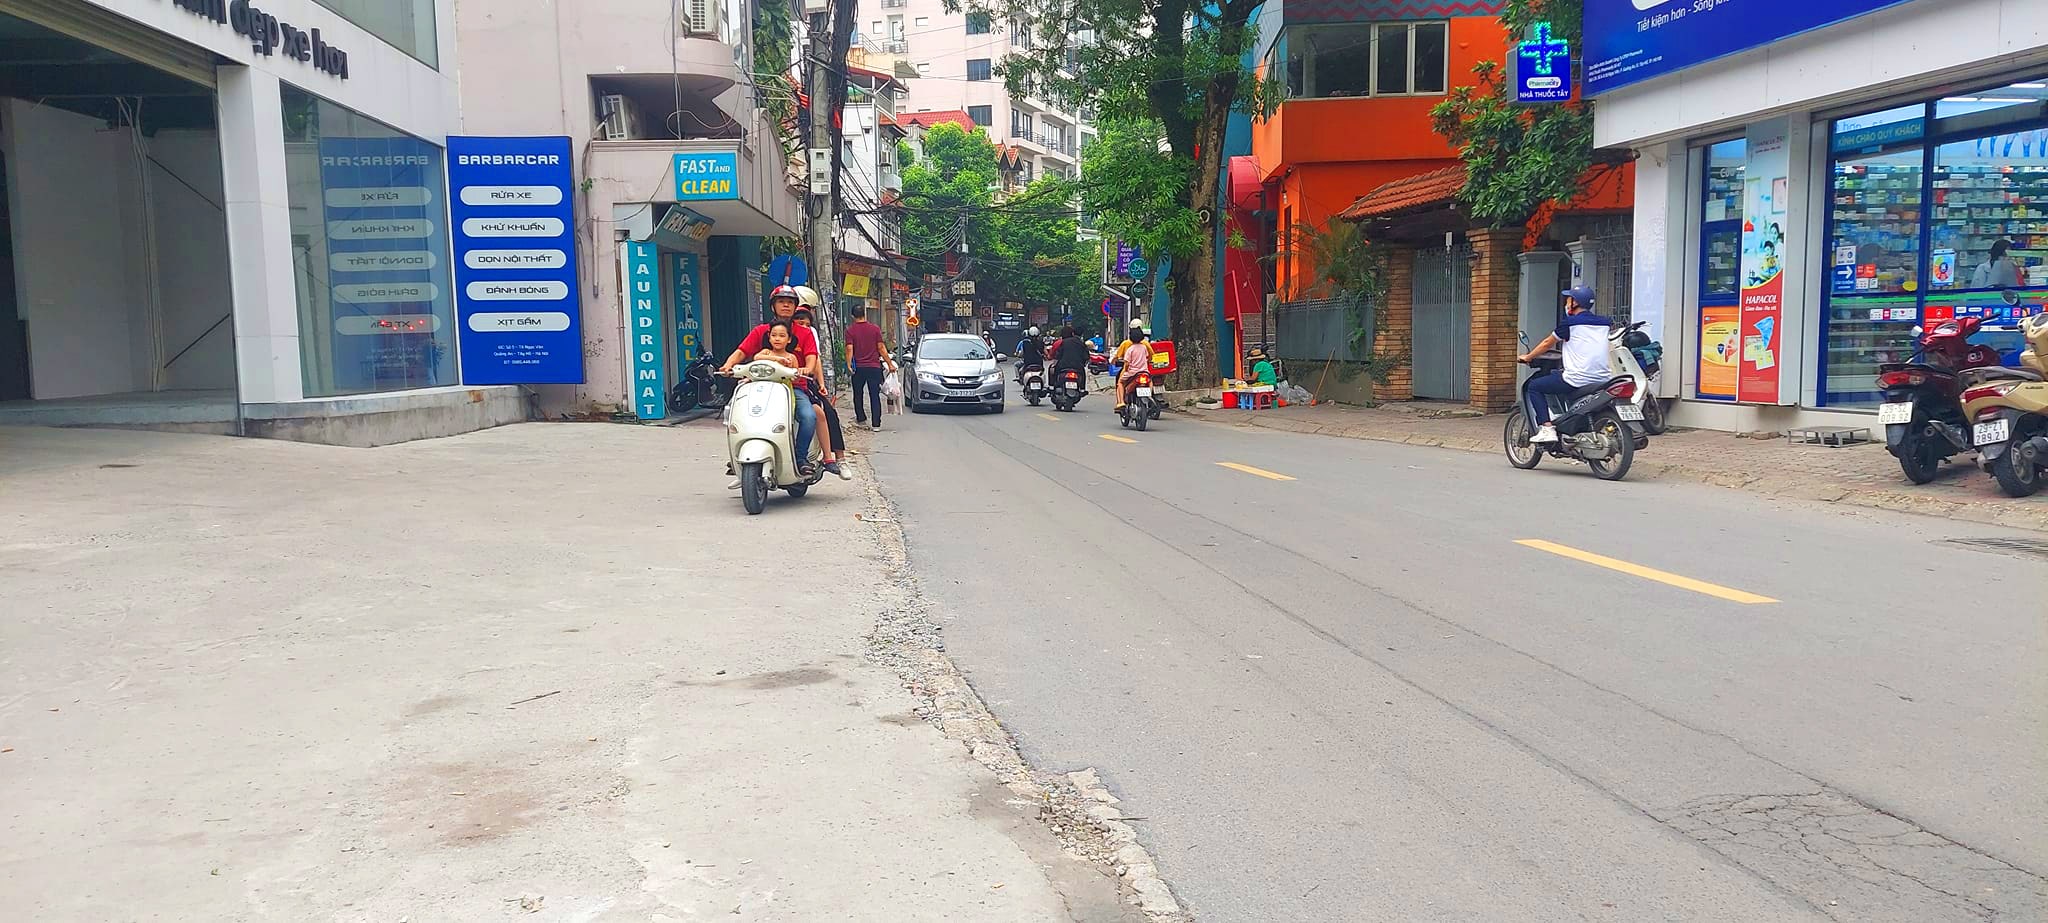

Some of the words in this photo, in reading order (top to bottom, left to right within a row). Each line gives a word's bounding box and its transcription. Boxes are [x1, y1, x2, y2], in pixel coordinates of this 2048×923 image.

[1650, 12, 1669, 28] kiệm
[280, 23, 311, 62] xe
[458, 155, 560, 165] BARBARCAR
[680, 159, 716, 174] FAST
[714, 165, 731, 173] AND
[681, 180, 731, 194] CLEAN
[504, 255, 521, 264] NỘI
[1745, 294, 1777, 305] HAPACOL
[636, 246, 657, 415] LAUNDROMAT
[1978, 421, 2002, 433] 29-Z1
[1975, 430, 2006, 444] 289.21
